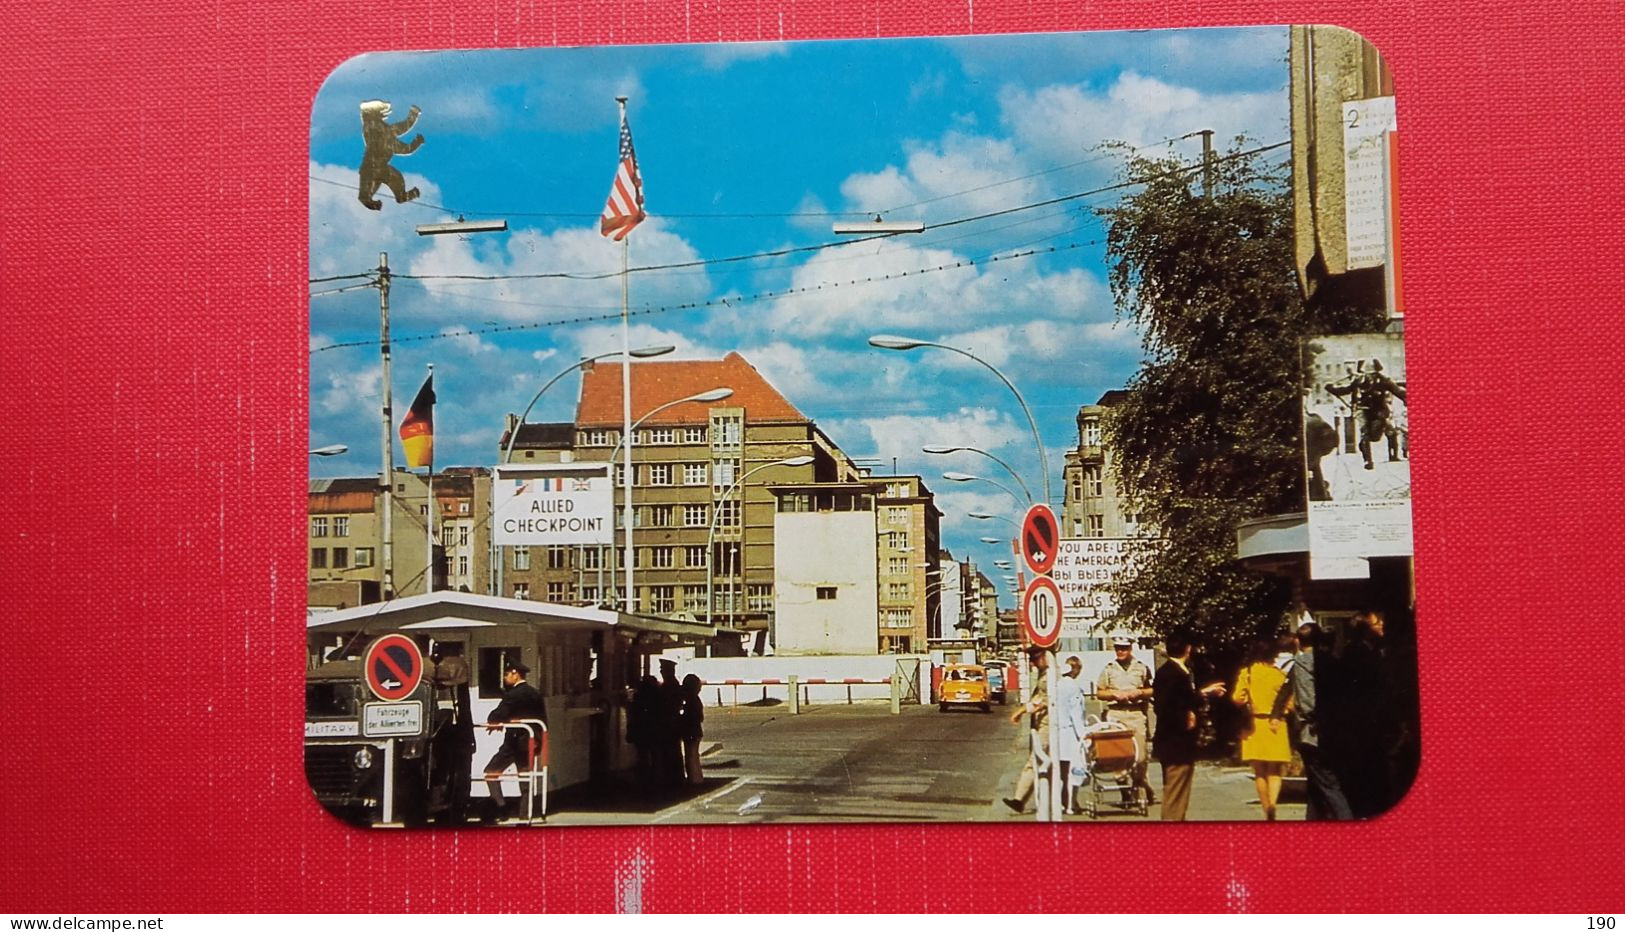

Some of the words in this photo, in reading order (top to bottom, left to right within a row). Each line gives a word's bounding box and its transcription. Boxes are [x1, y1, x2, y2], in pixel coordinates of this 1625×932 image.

[531, 498, 574, 513] ALLIED
[503, 517, 604, 534] CHECKPOINT
[1059, 543, 1081, 553] YOU
[1087, 543, 1109, 553] ARE
[1057, 556, 1070, 566] HE
[1054, 570, 1072, 580] ВЫ
[1033, 593, 1048, 630] 10
[376, 707, 409, 718] Fahrzeuge
